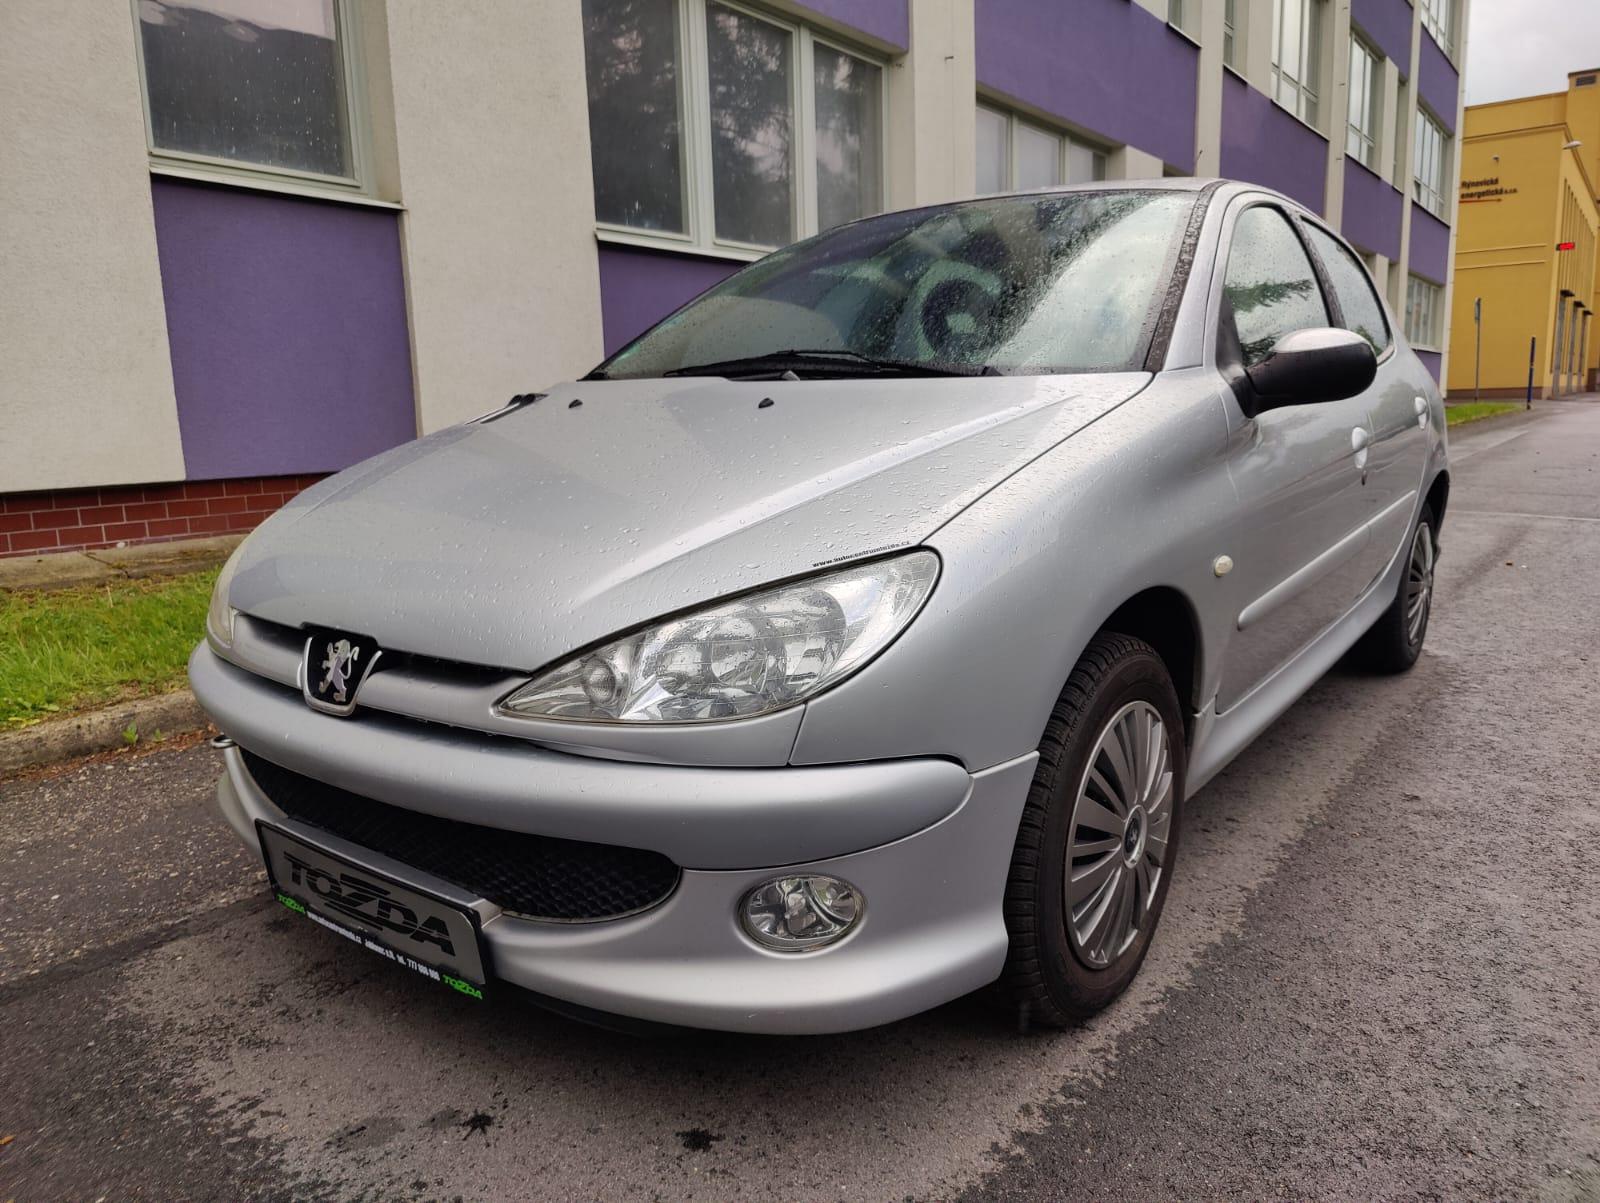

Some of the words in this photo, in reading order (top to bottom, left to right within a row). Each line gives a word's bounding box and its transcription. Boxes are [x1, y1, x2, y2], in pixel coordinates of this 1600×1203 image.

[278, 895, 306, 914] TOZDA
[444, 975, 483, 1000] TOZDA
[284, 851, 456, 957] TOZDA
